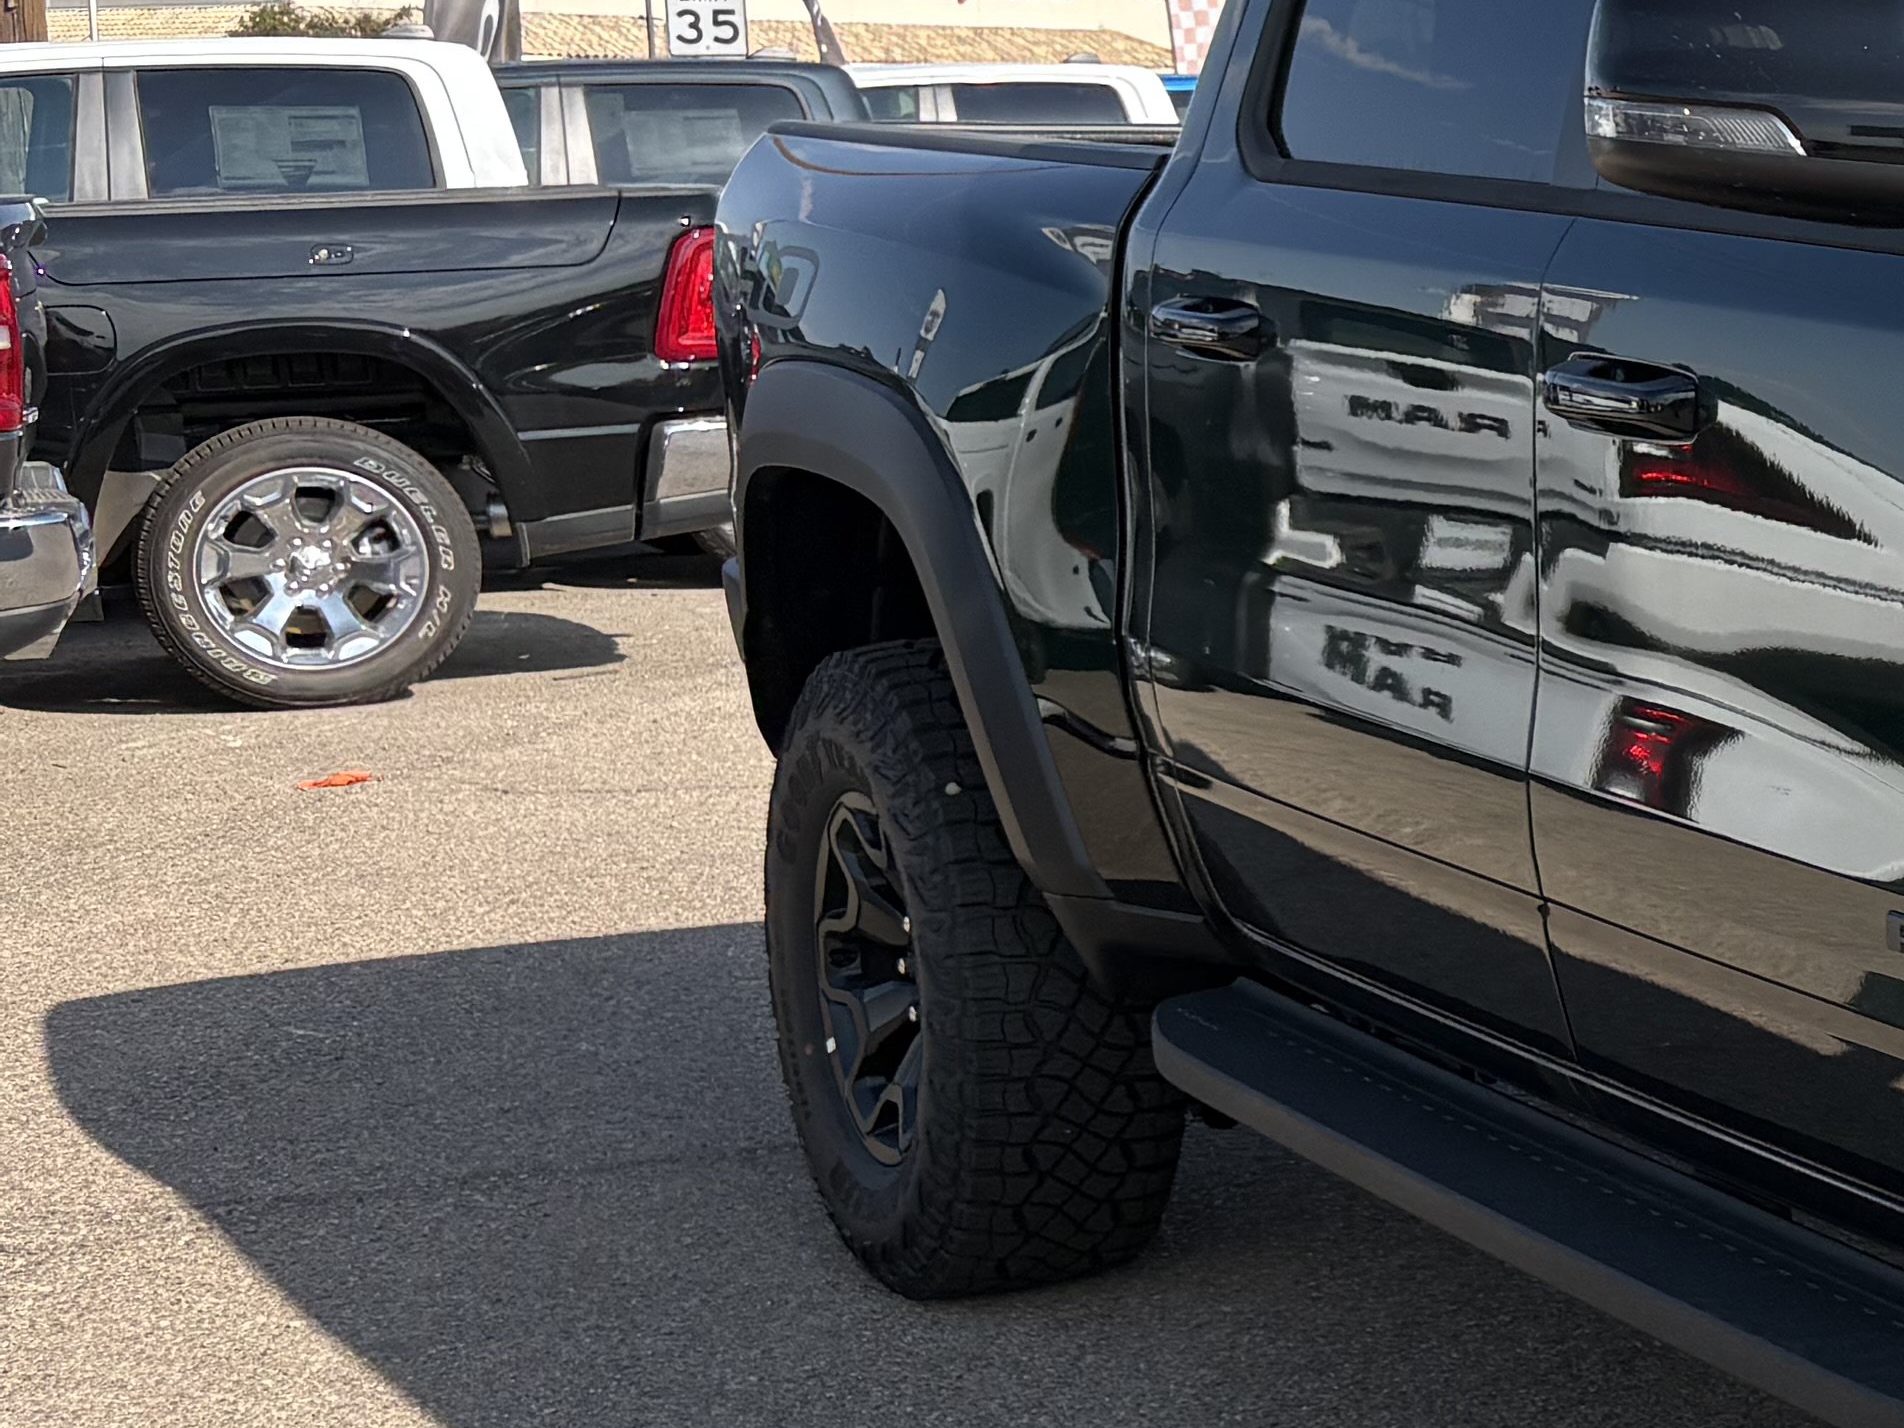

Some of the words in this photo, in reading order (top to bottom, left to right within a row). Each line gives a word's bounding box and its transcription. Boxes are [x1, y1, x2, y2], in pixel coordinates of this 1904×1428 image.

[675, 8, 740, 45] 35
[353, 455, 455, 570] DUELER
[165, 489, 280, 685] BRIDGESTONE
